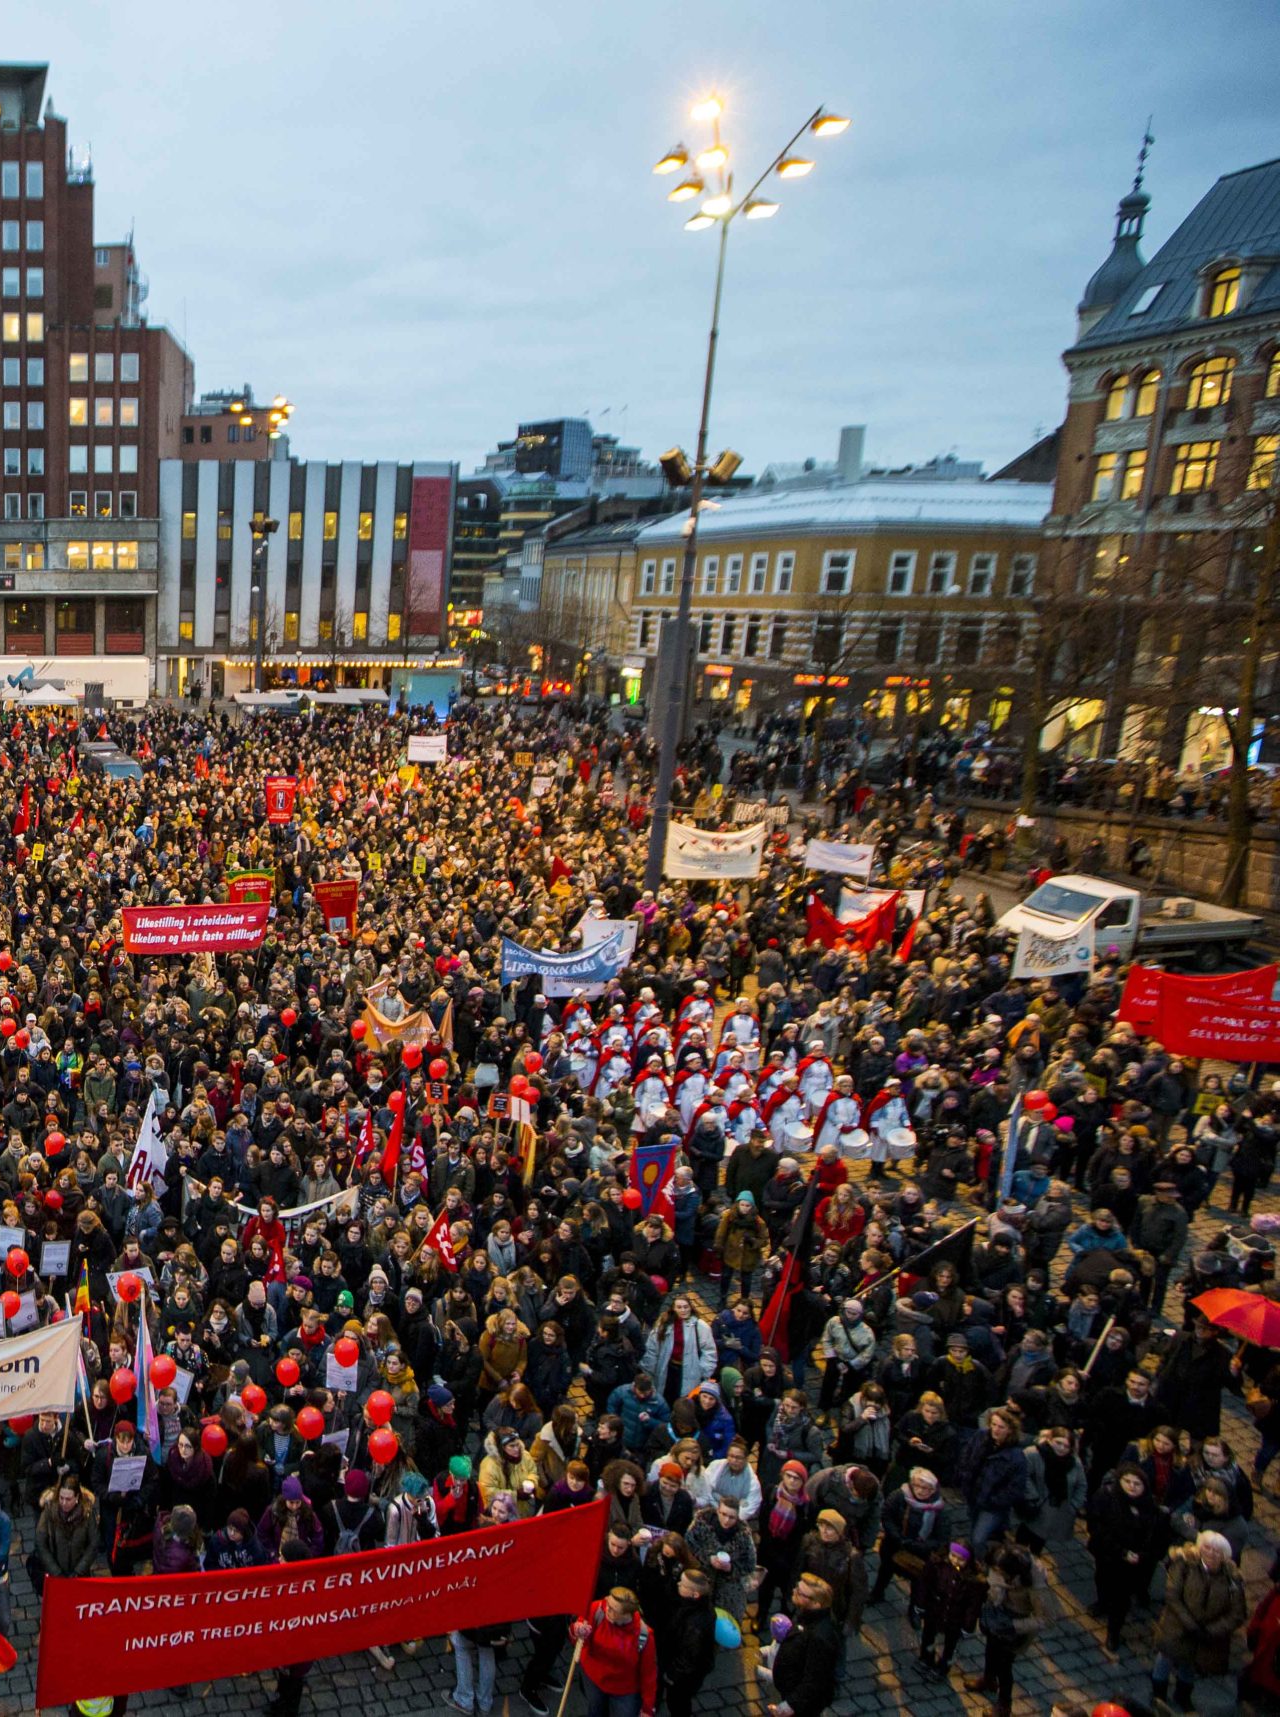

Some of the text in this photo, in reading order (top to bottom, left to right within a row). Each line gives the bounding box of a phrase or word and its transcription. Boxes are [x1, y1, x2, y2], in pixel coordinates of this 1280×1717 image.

[130, 928, 262, 945] Likelønn og hele faste stillinger
[136, 917, 184, 930] Likestilling
[187, 916, 191, 926] i
[193, 914, 244, 926] arbeidslivet
[75, 1539, 515, 1620] TRANSRETTIGHETER ER KVINNEKAMP
[125, 1575, 478, 1651] INNFØR TREDJE KJØNNSALTERNATIV NÅ!
